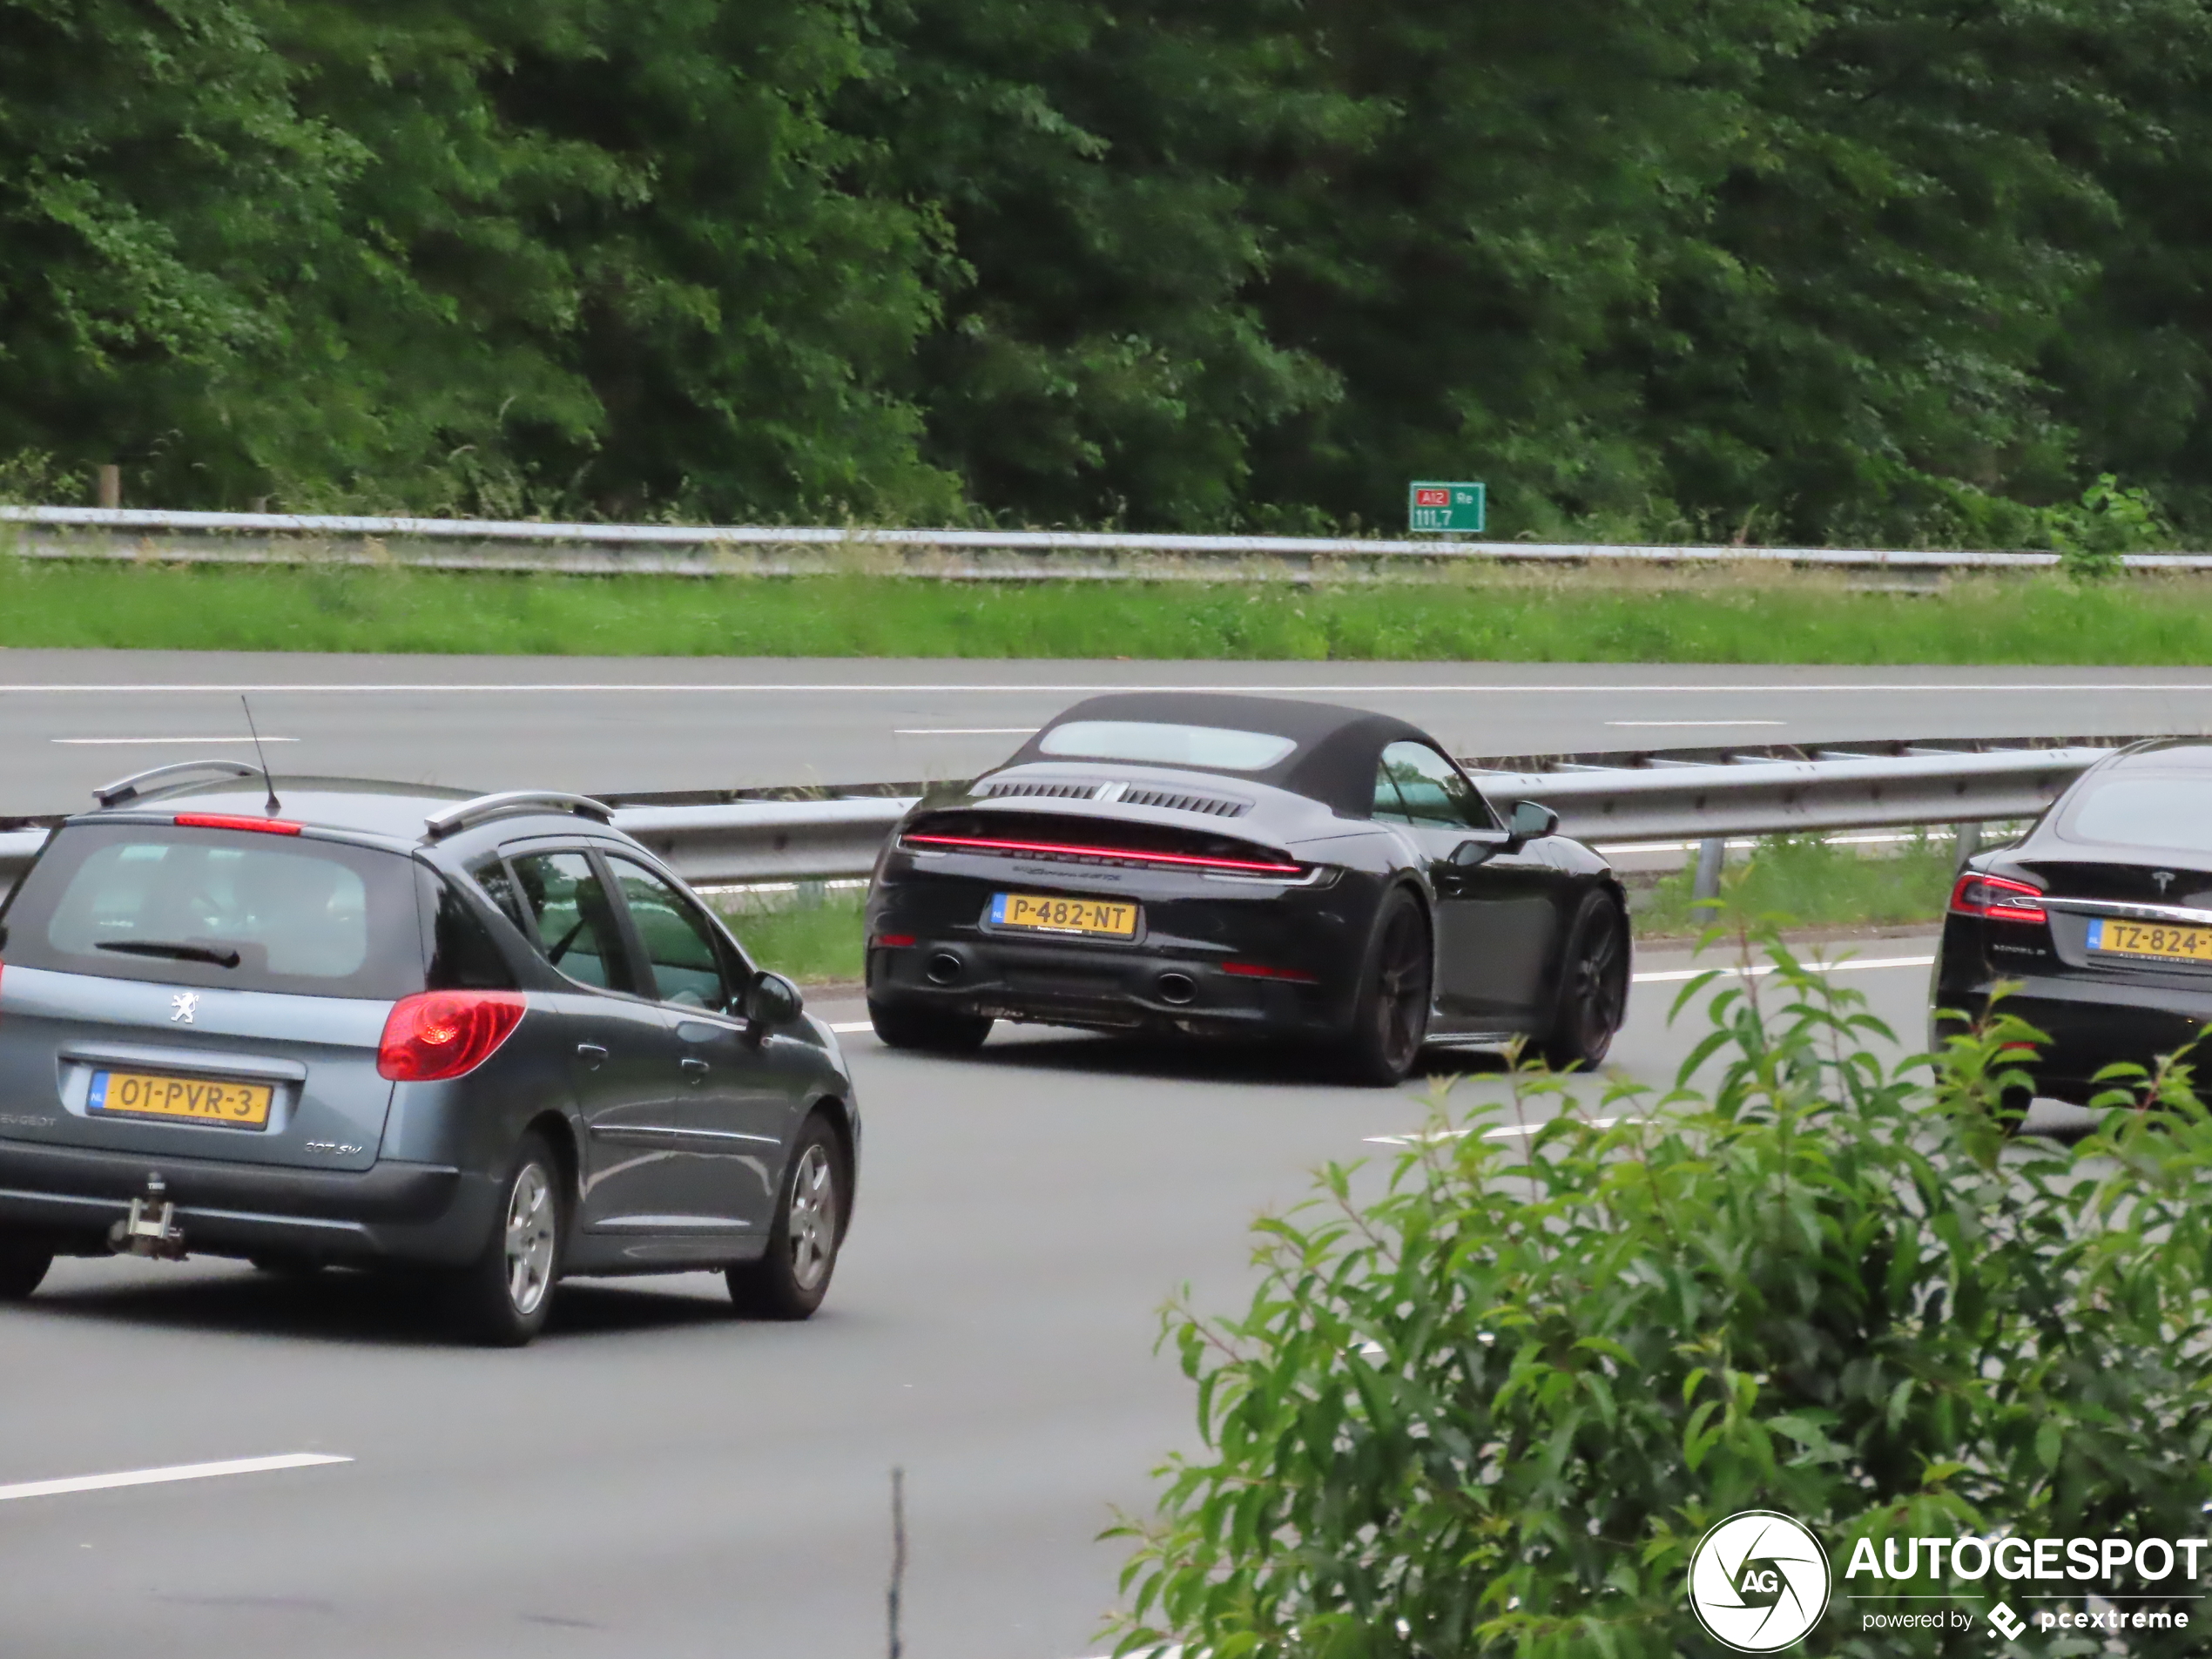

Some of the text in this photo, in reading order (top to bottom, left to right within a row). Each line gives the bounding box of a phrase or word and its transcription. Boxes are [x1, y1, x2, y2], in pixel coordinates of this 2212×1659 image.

[1421, 492, 1474, 503] A12 Re
[1014, 899, 1126, 929] P-482-NT
[2114, 926, 2212, 954] TZ-824-
[91, 1093, 102, 1102] NL
[121, 1079, 252, 1116] 01-PVR-3
[0, 1115, 57, 1126] EUGEOT
[336, 1145, 362, 1155] SW
